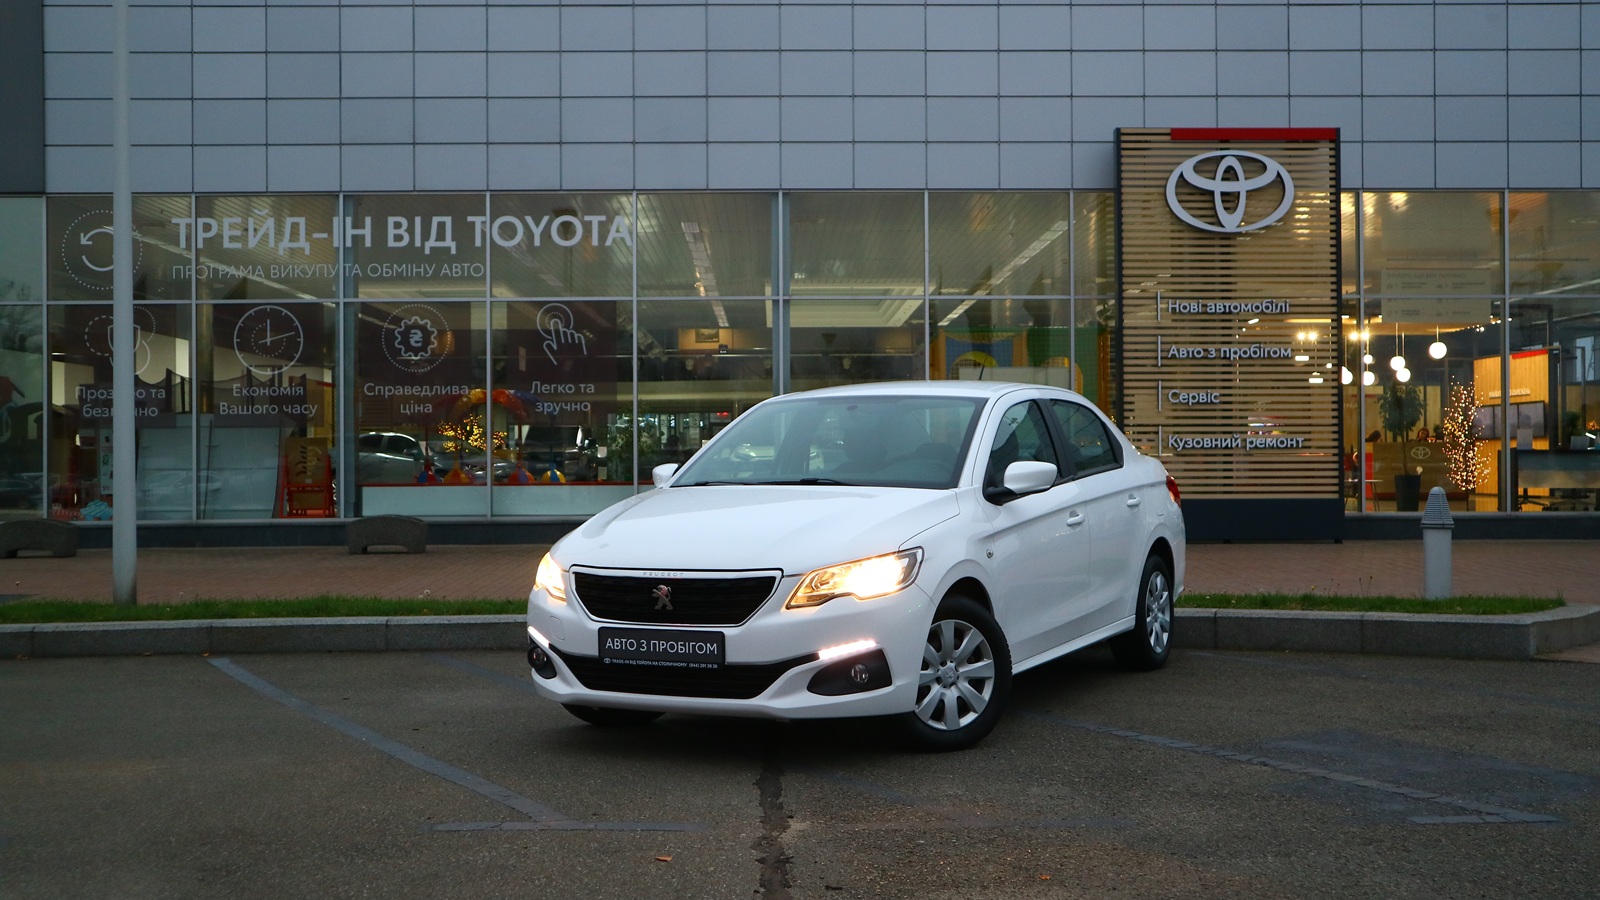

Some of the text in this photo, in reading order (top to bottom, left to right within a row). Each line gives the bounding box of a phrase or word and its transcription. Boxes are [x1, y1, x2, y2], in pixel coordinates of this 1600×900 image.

[171, 208, 633, 256] ТРЕЙД-ІН ВІД TOYOTA
[172, 262, 485, 280] ПРОГРАМА ВИКУПУ ТА ОБМІНУ АВТО
[1168, 299, 1290, 313] Нові автомобілі
[1168, 344, 1292, 361] Авто з пробігом
[75, 386, 166, 402] Прозо та
[232, 383, 304, 396] Економія
[363, 382, 469, 397] Справедлива
[530, 381, 595, 394] Легко та
[1168, 389, 1220, 406] Сервіс
[219, 402, 318, 418] Вашого часу
[400, 400, 433, 415] ціна
[535, 402, 591, 415] зручно
[1168, 434, 1305, 452] Кузовний ремонт
[605, 637, 637, 651] АВТО
[650, 640, 718, 655] ПРОБІГОМ
